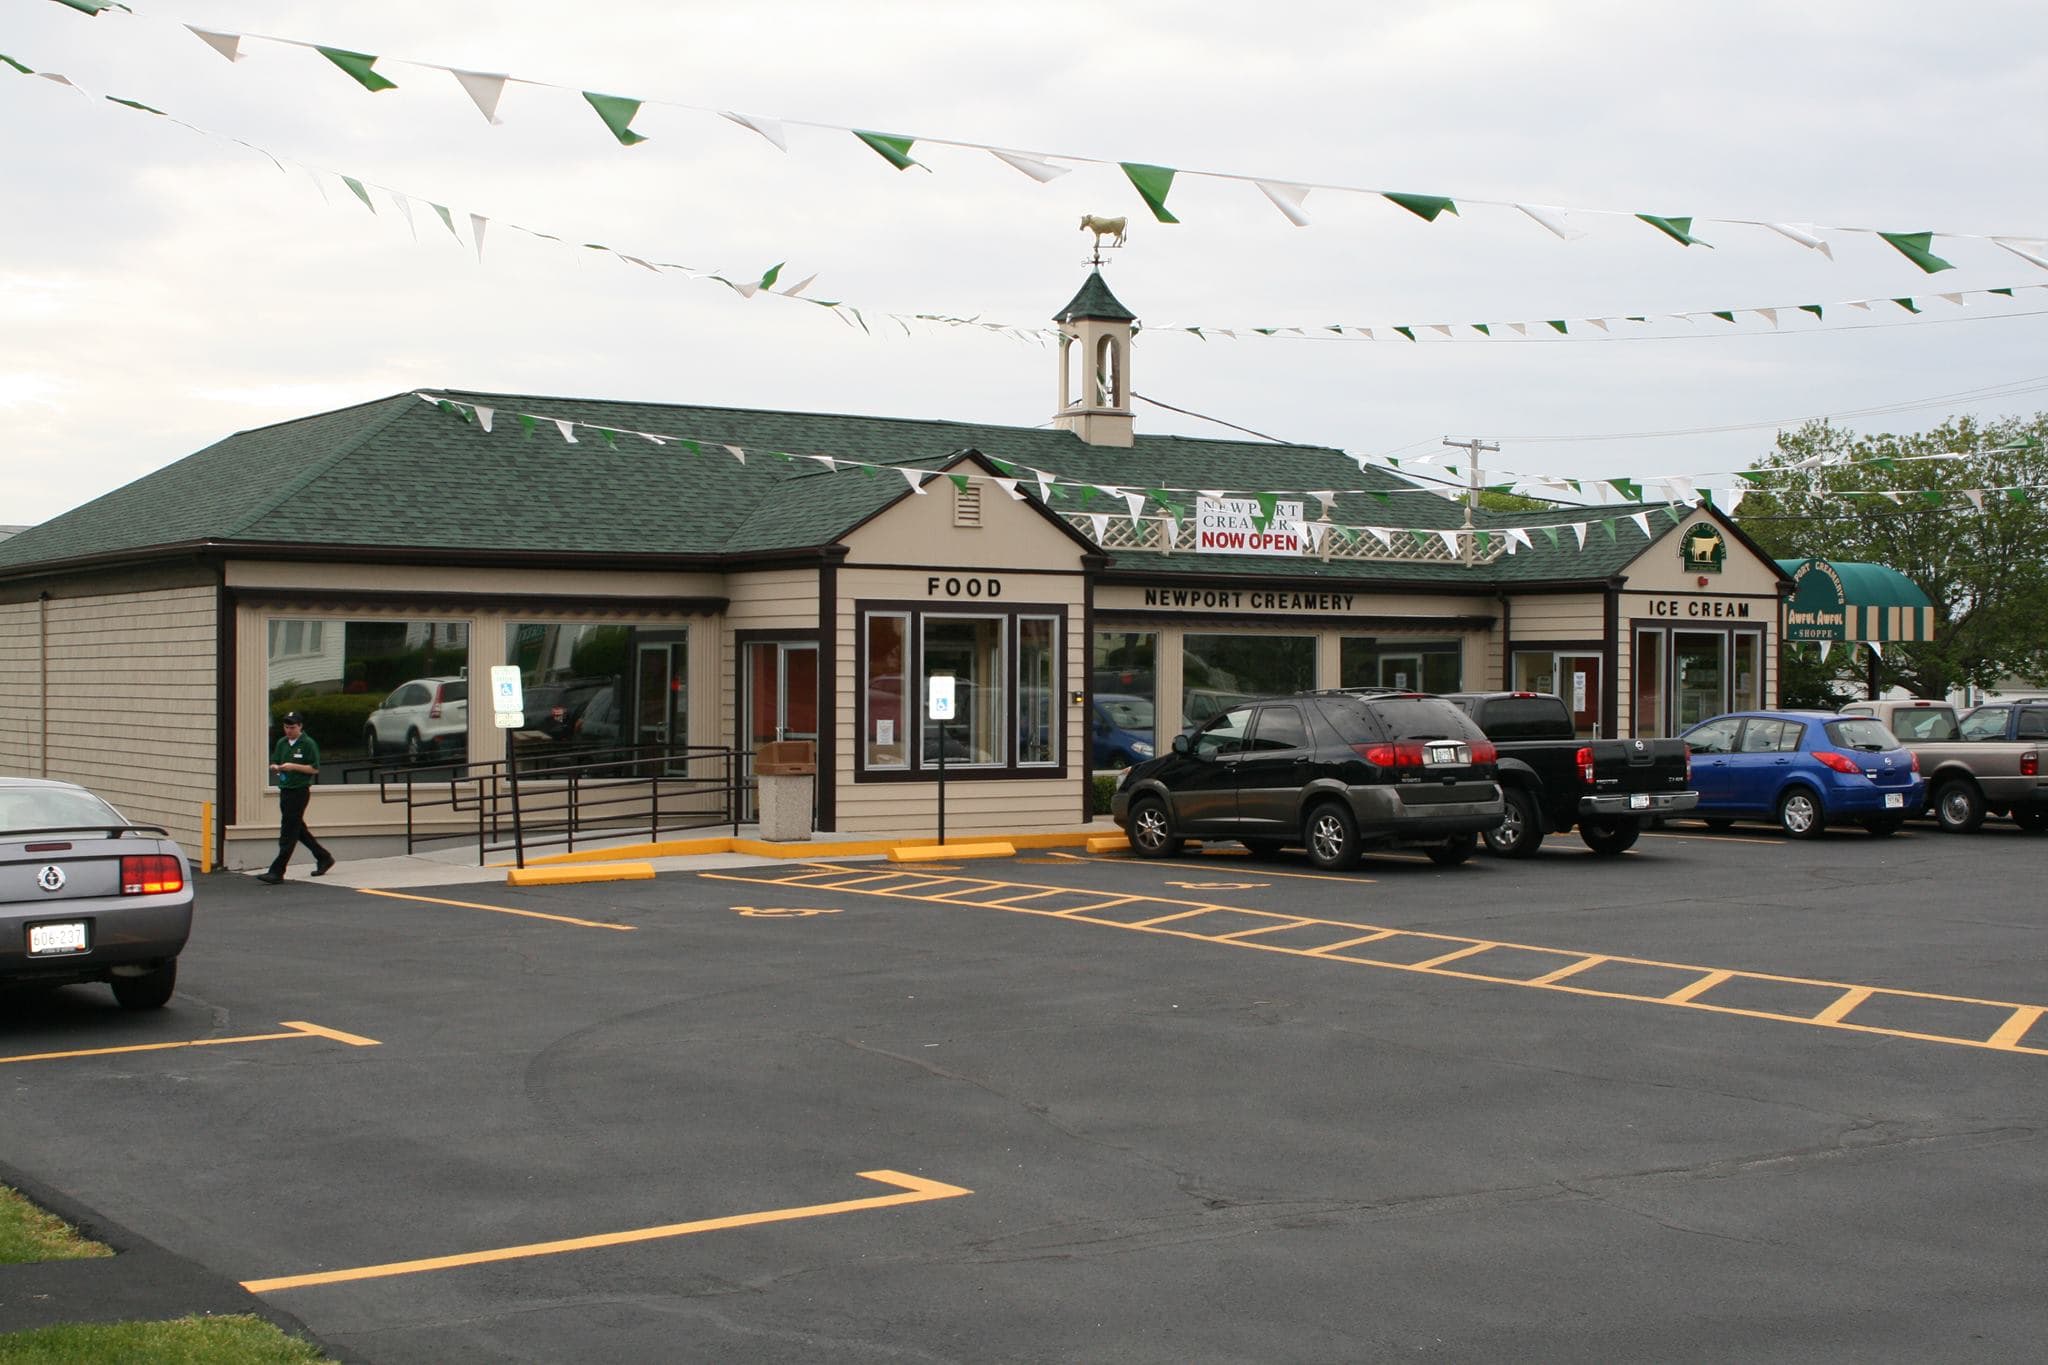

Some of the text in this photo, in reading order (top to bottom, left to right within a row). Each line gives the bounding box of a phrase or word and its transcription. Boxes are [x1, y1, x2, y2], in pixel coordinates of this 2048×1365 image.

[1203, 501, 1298, 516] NEWPRT
[1203, 515, 1296, 531] CREAER
[1202, 531, 1298, 551] NOW OPEN
[928, 577, 1001, 597] FOOD
[1788, 562, 1810, 602] NPORT
[1145, 589, 1354, 611] NEWPORT CREAMERY
[1649, 600, 1749, 617] ICE CREAM
[1799, 629, 1832, 638] SHOPPE
